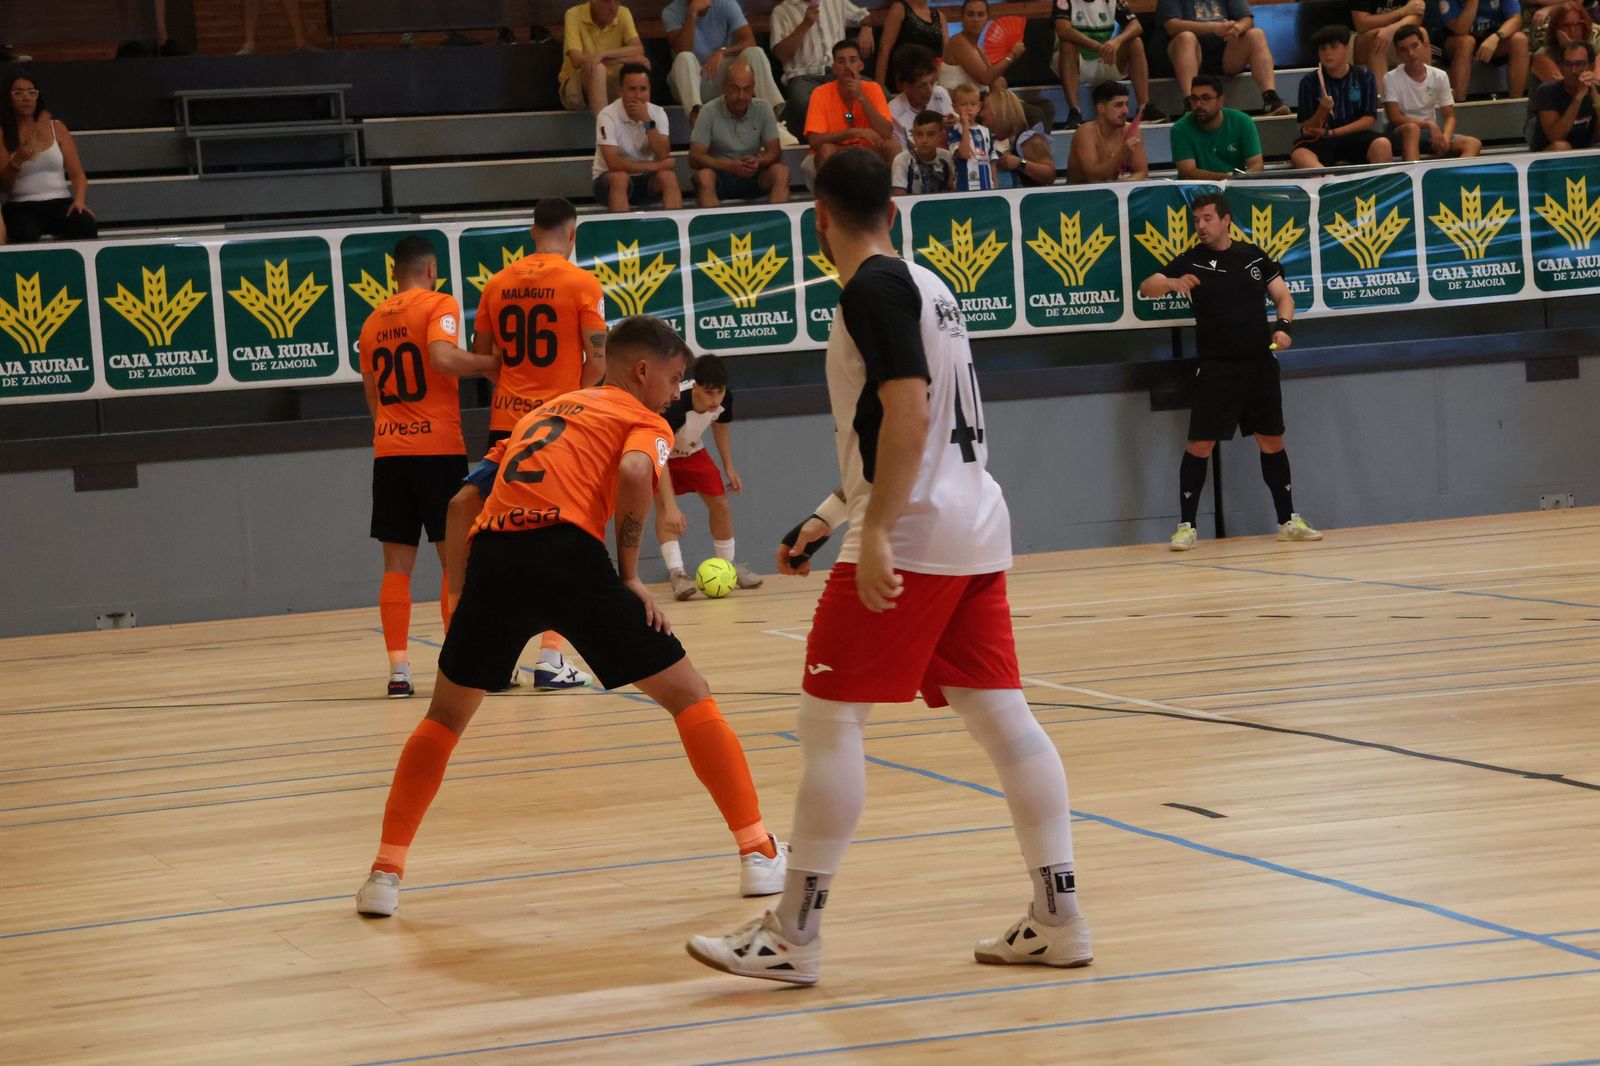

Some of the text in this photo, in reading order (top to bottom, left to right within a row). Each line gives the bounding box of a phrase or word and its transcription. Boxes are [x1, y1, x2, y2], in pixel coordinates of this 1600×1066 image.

[1432, 262, 1521, 281] CAJA RURAL
[1537, 257, 1574, 272] CAJA
[1327, 271, 1416, 290] CAJA RURAL
[1553, 269, 1600, 281] DE ZAMO
[1448, 278, 1506, 290] DE ZAMORA
[501, 287, 555, 300] MALAGUTI
[1029, 293, 1067, 307] CAJA
[1069, 290, 1120, 305] RURAL
[1343, 287, 1401, 299] DE ZAMORA
[961, 297, 1012, 311] RURAL
[1046, 306, 1104, 317] DE ZAMORA
[1153, 301, 1190, 310] DE ZAM
[699, 314, 737, 329] CAJA
[740, 311, 793, 327] RURAL
[965, 312, 997, 322] MORA
[376, 326, 408, 343] CHINO
[499, 303, 558, 368] 96
[716, 327, 778, 339] DE ZAMORA
[109, 349, 213, 369] CAJA RURAL
[232, 345, 274, 361] CAJA
[277, 342, 334, 358] RURAL
[29, 357, 89, 374] RURAL
[128, 366, 196, 379] DE ZAMORA
[251, 359, 318, 371] DE ZAMORA
[2, 374, 72, 387] DE ZAMORA
[372, 341, 427, 406] 20
[377, 420, 432, 436] uvesa
[502, 415, 567, 484] 2
